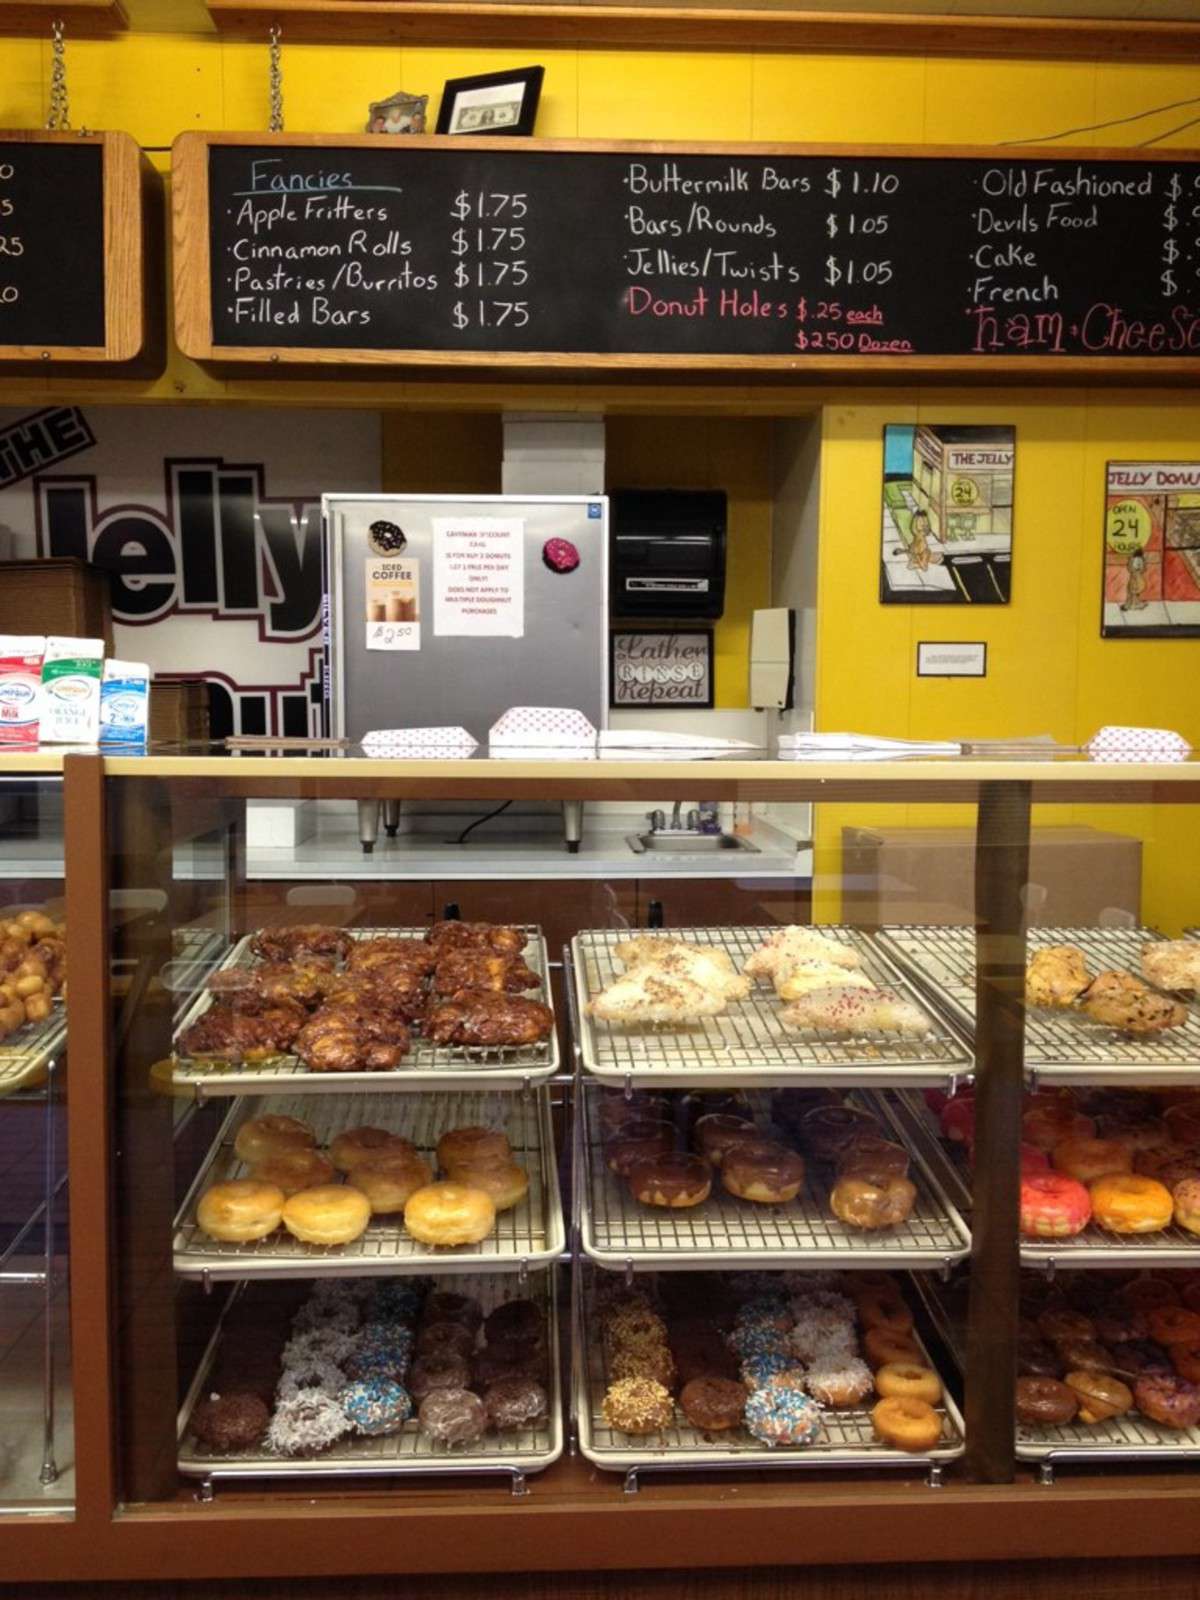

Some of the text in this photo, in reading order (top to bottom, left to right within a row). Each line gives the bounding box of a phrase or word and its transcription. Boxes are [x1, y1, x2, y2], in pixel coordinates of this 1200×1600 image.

[251, 159, 353, 191] Fancies
[629, 163, 749, 194] Buttermilk
[761, 167, 811, 192] Bars
[983, 168, 1027, 197] Old
[1033, 166, 1152, 197] Fashioned
[236, 190, 528, 234] Apple Fritters $1.75
[977, 203, 1039, 234] Devils
[1046, 202, 1098, 229] Food
[233, 228, 527, 260] Cinnamon Rolls $1.75
[975, 243, 1038, 269] Cake
[453, 261, 529, 288] $1.75
[973, 275, 1059, 302] French
[235, 296, 530, 329] Filled Bars $1.75
[628, 286, 709, 317] Donut
[719, 288, 789, 319] Holes
[846, 304, 883, 324] each
[858, 333, 913, 351] Dozen
[951, 452, 1014, 465] THE JELLY
[955, 486, 971, 498] 24
[1108, 471, 1152, 486] JELLY
[1111, 519, 1139, 538] 24
[372, 570, 413, 580] COFFEE
[382, 563, 403, 571] ICED
[616, 633, 708, 661] Lather
[617, 680, 704, 703] Repeat
